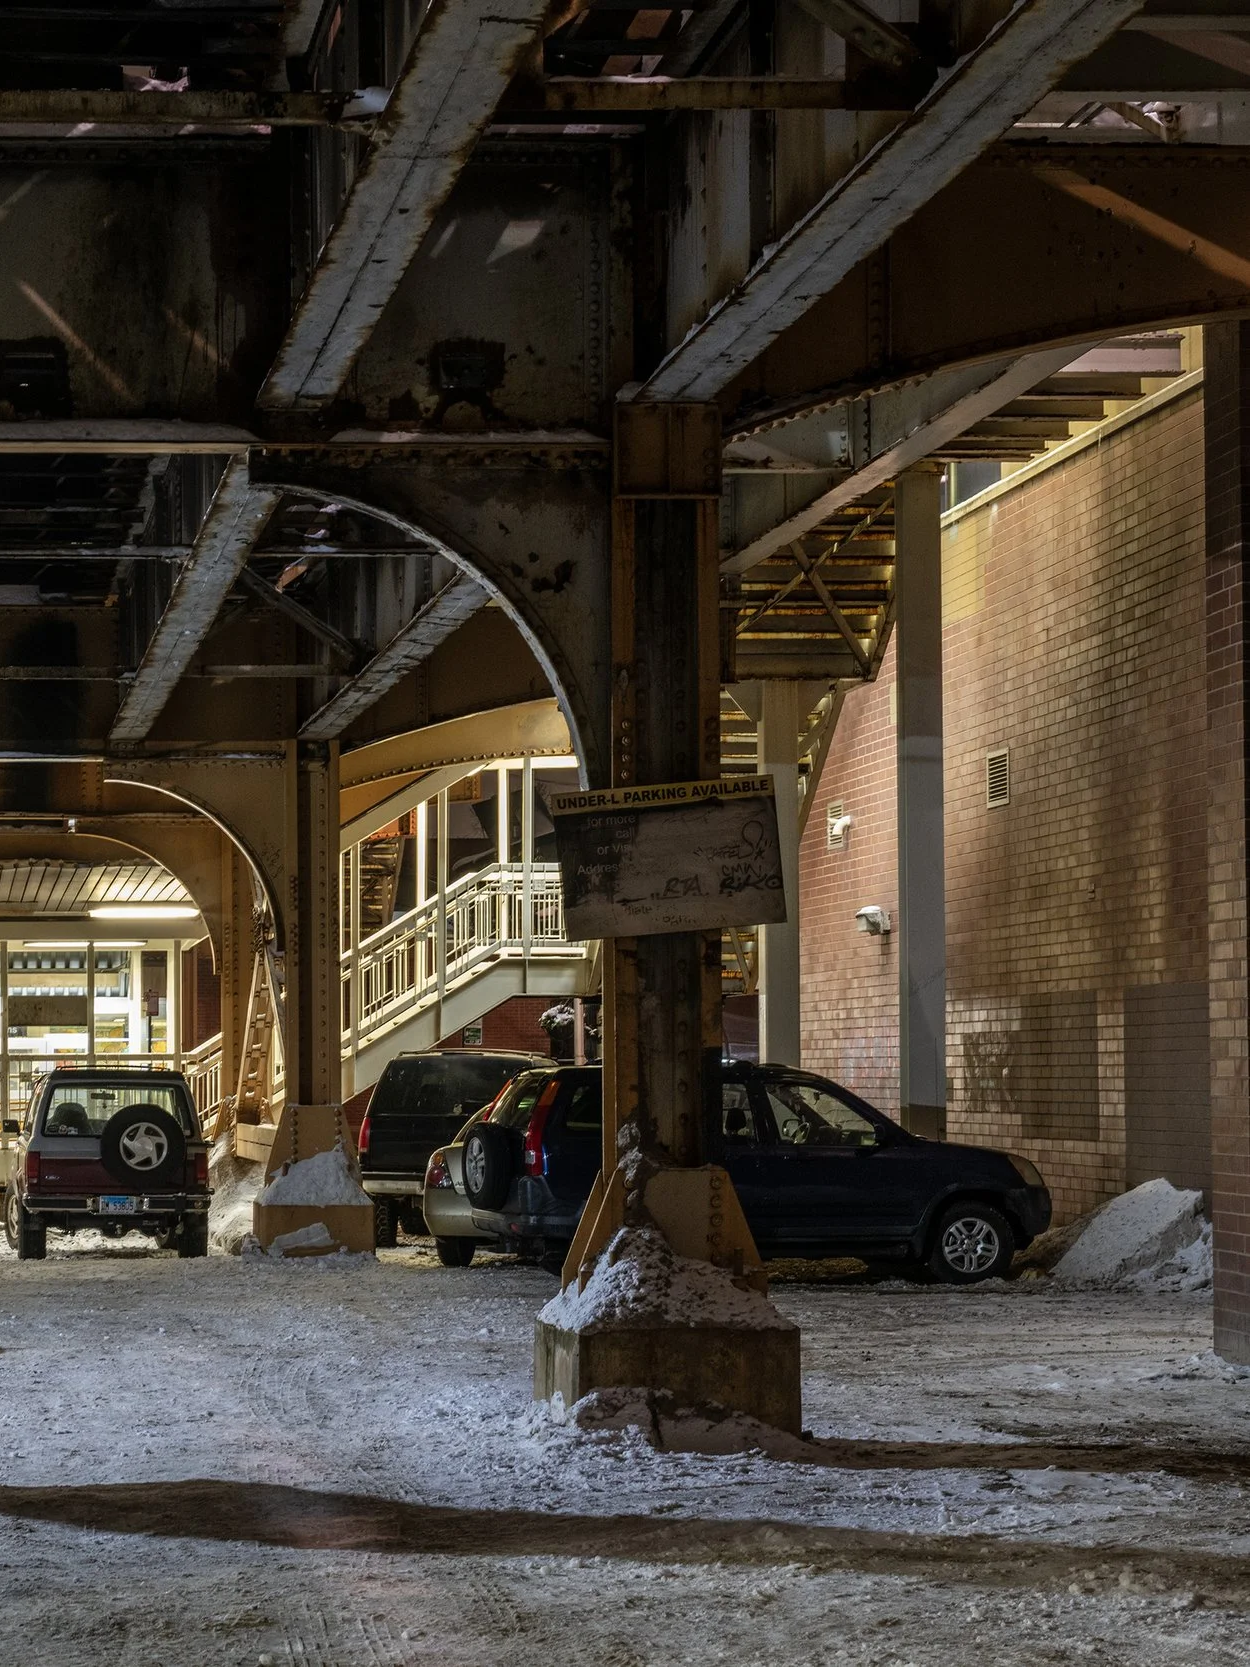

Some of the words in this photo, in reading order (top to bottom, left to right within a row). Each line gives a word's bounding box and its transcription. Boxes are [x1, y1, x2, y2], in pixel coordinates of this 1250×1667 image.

[556, 794, 619, 810] UNDER-L
[624, 787, 686, 804] PARKING
[692, 780, 769, 798] AVAILABLE
[606, 814, 636, 826] more
[597, 846, 610, 856] or
